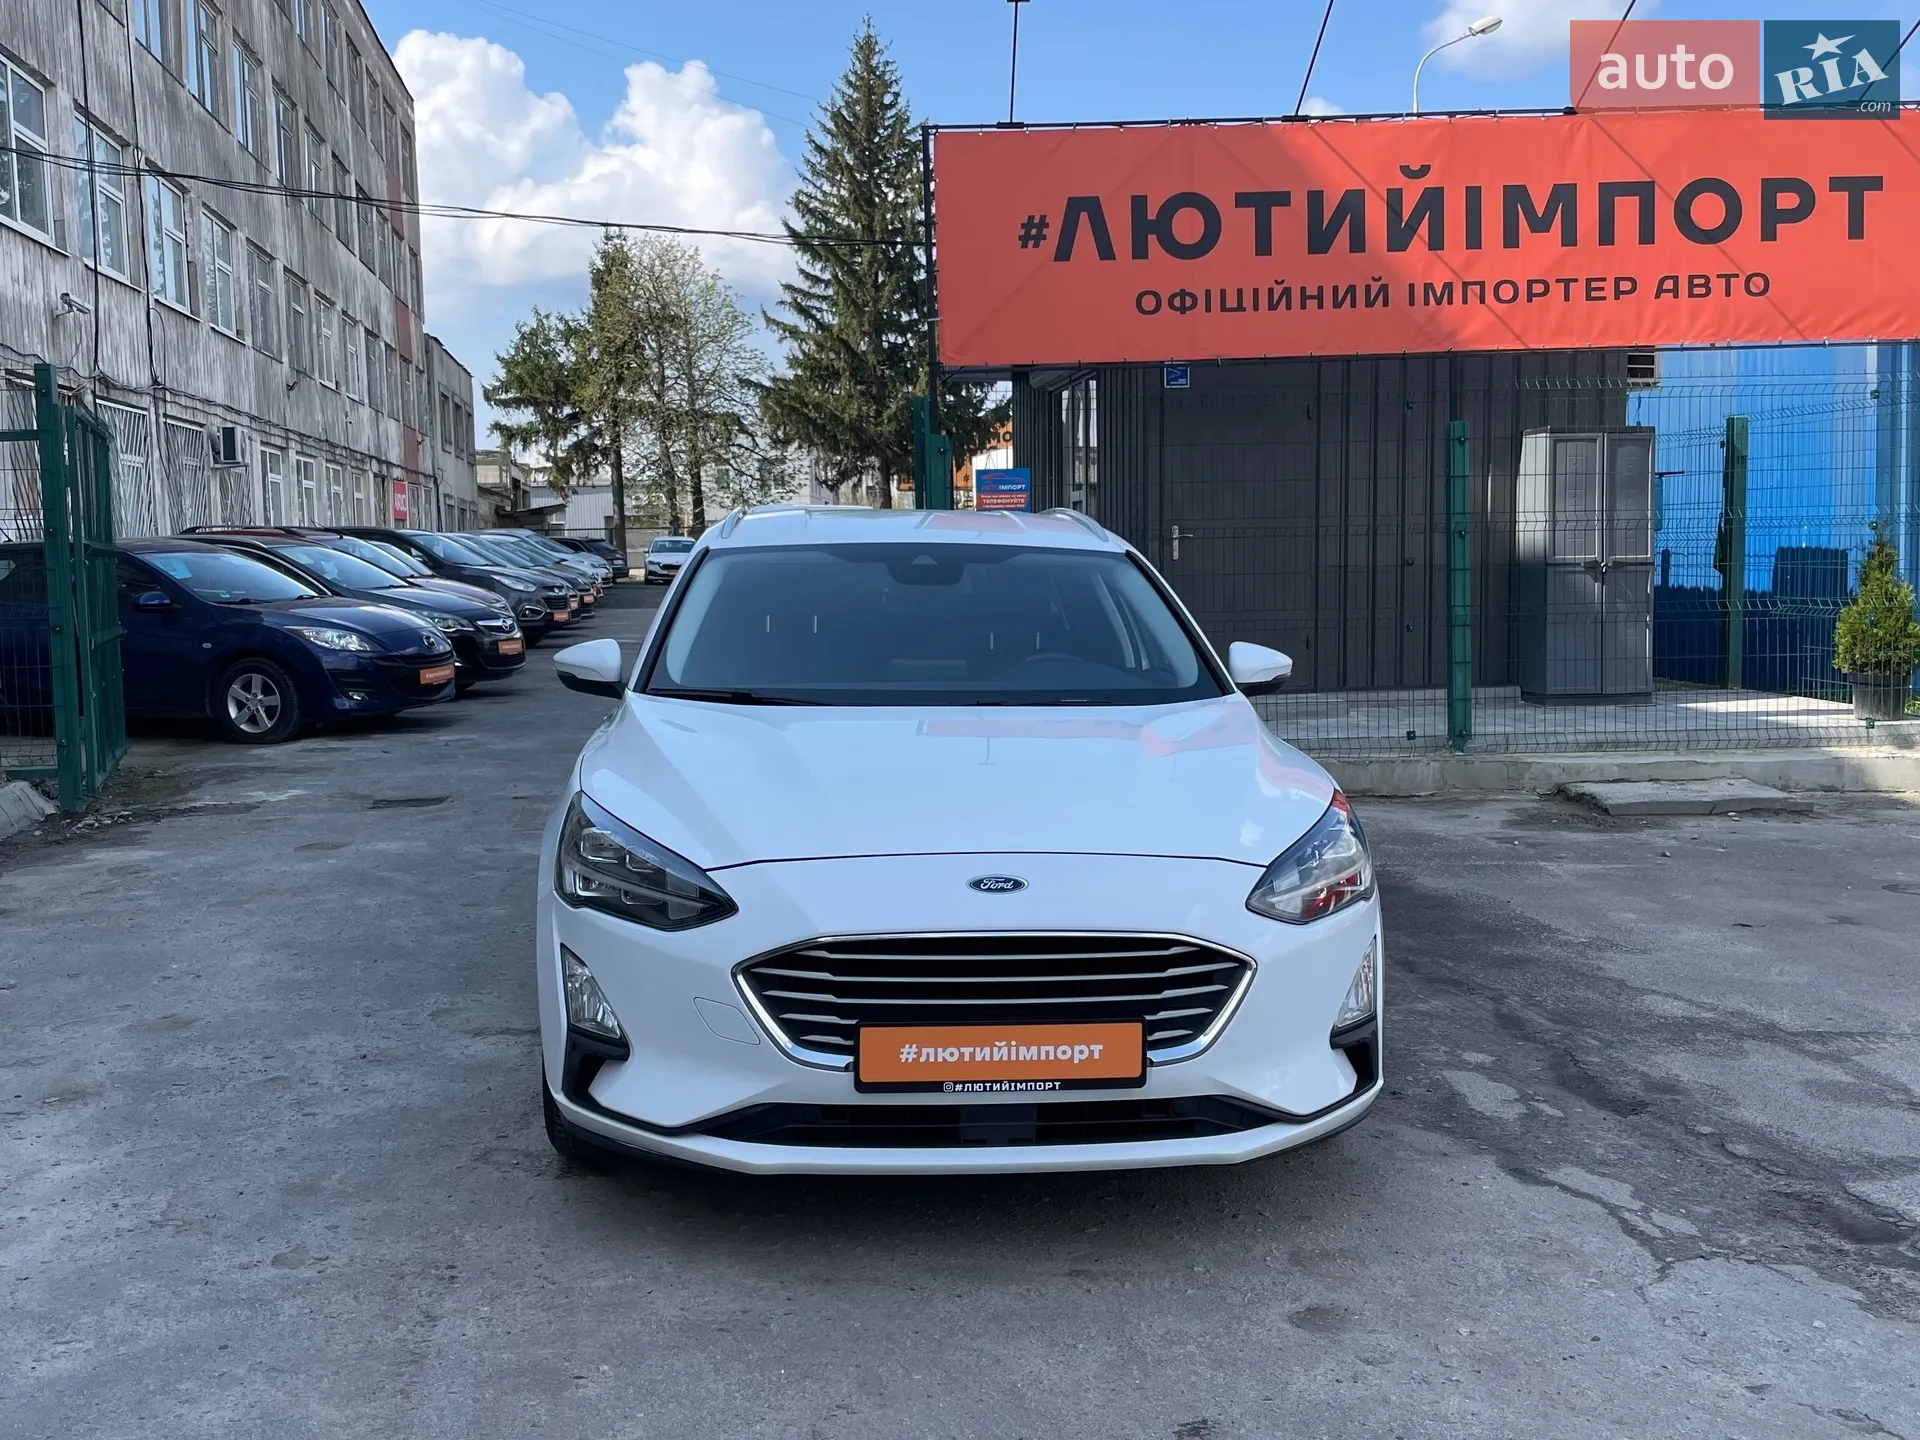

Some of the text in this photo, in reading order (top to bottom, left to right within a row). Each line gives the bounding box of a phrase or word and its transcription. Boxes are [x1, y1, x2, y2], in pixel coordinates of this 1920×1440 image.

[1018, 164, 1885, 263] #ЛЮТИЙІМПОРТ
[1135, 272, 1771, 316] ОФІЦІЙНИЙ ІМПОРТЕР АВТО
[980, 876, 1015, 890] Ford
[899, 1040, 1104, 1064] #лютийімпорт
[954, 1080, 1062, 1093] #ЛЮТИЙІМПОРТ
